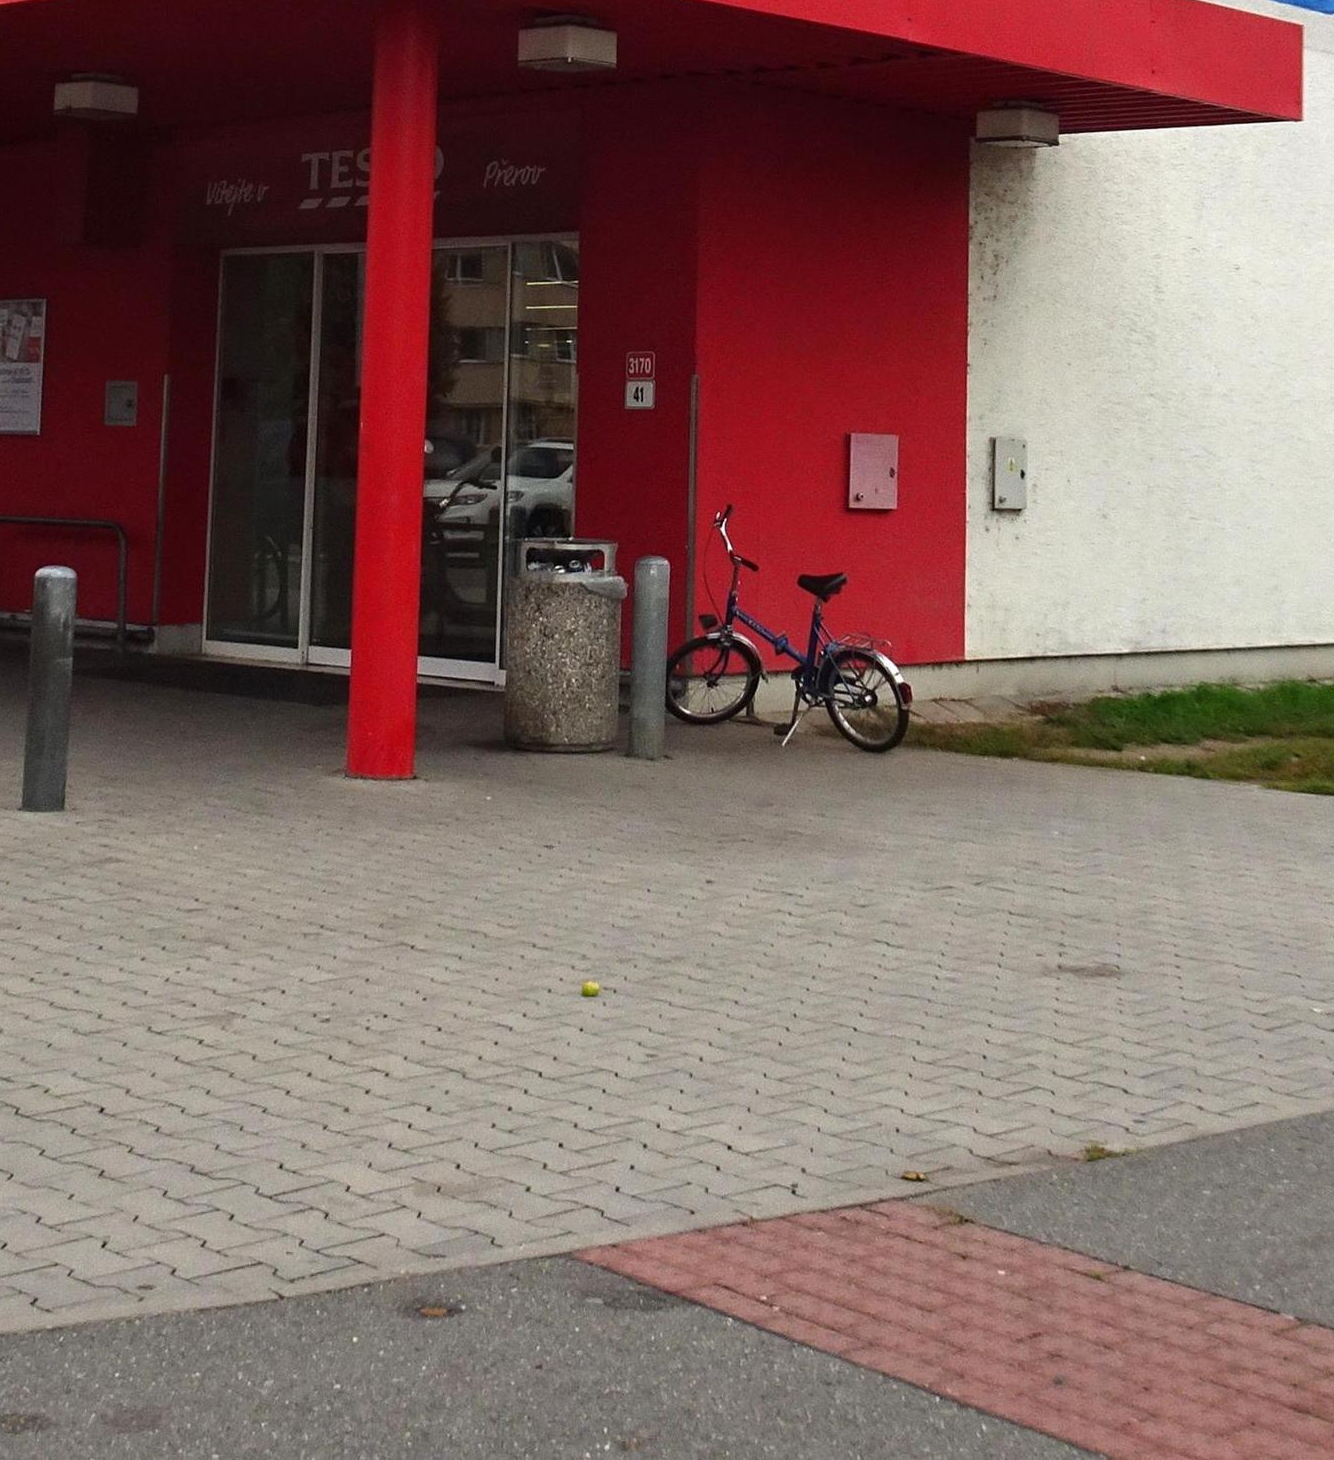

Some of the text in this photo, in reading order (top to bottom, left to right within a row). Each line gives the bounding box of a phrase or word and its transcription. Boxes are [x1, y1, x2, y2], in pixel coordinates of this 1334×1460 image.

[301, 145, 445, 191] TES
[484, 157, 546, 189] Přerov
[628, 357, 652, 374] 3170
[633, 386, 644, 403] 41
